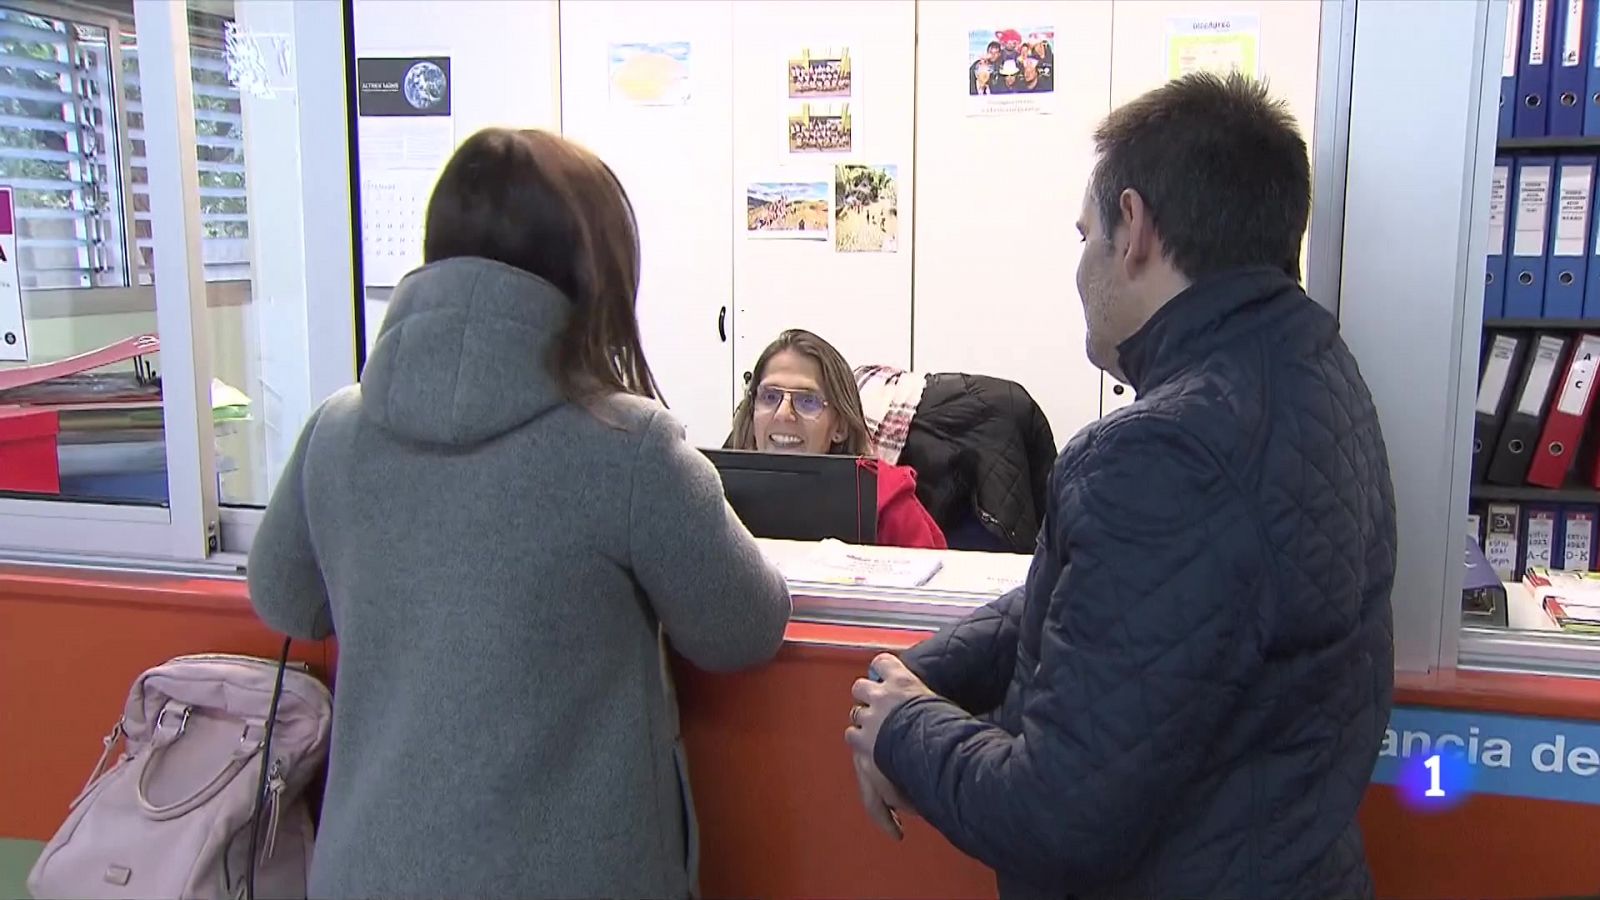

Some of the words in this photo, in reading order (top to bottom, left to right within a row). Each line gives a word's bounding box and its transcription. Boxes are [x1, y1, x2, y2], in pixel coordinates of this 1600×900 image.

[1583, 352, 1591, 361] A
[1575, 380, 1583, 389] C
[1531, 735, 1600, 776] de
